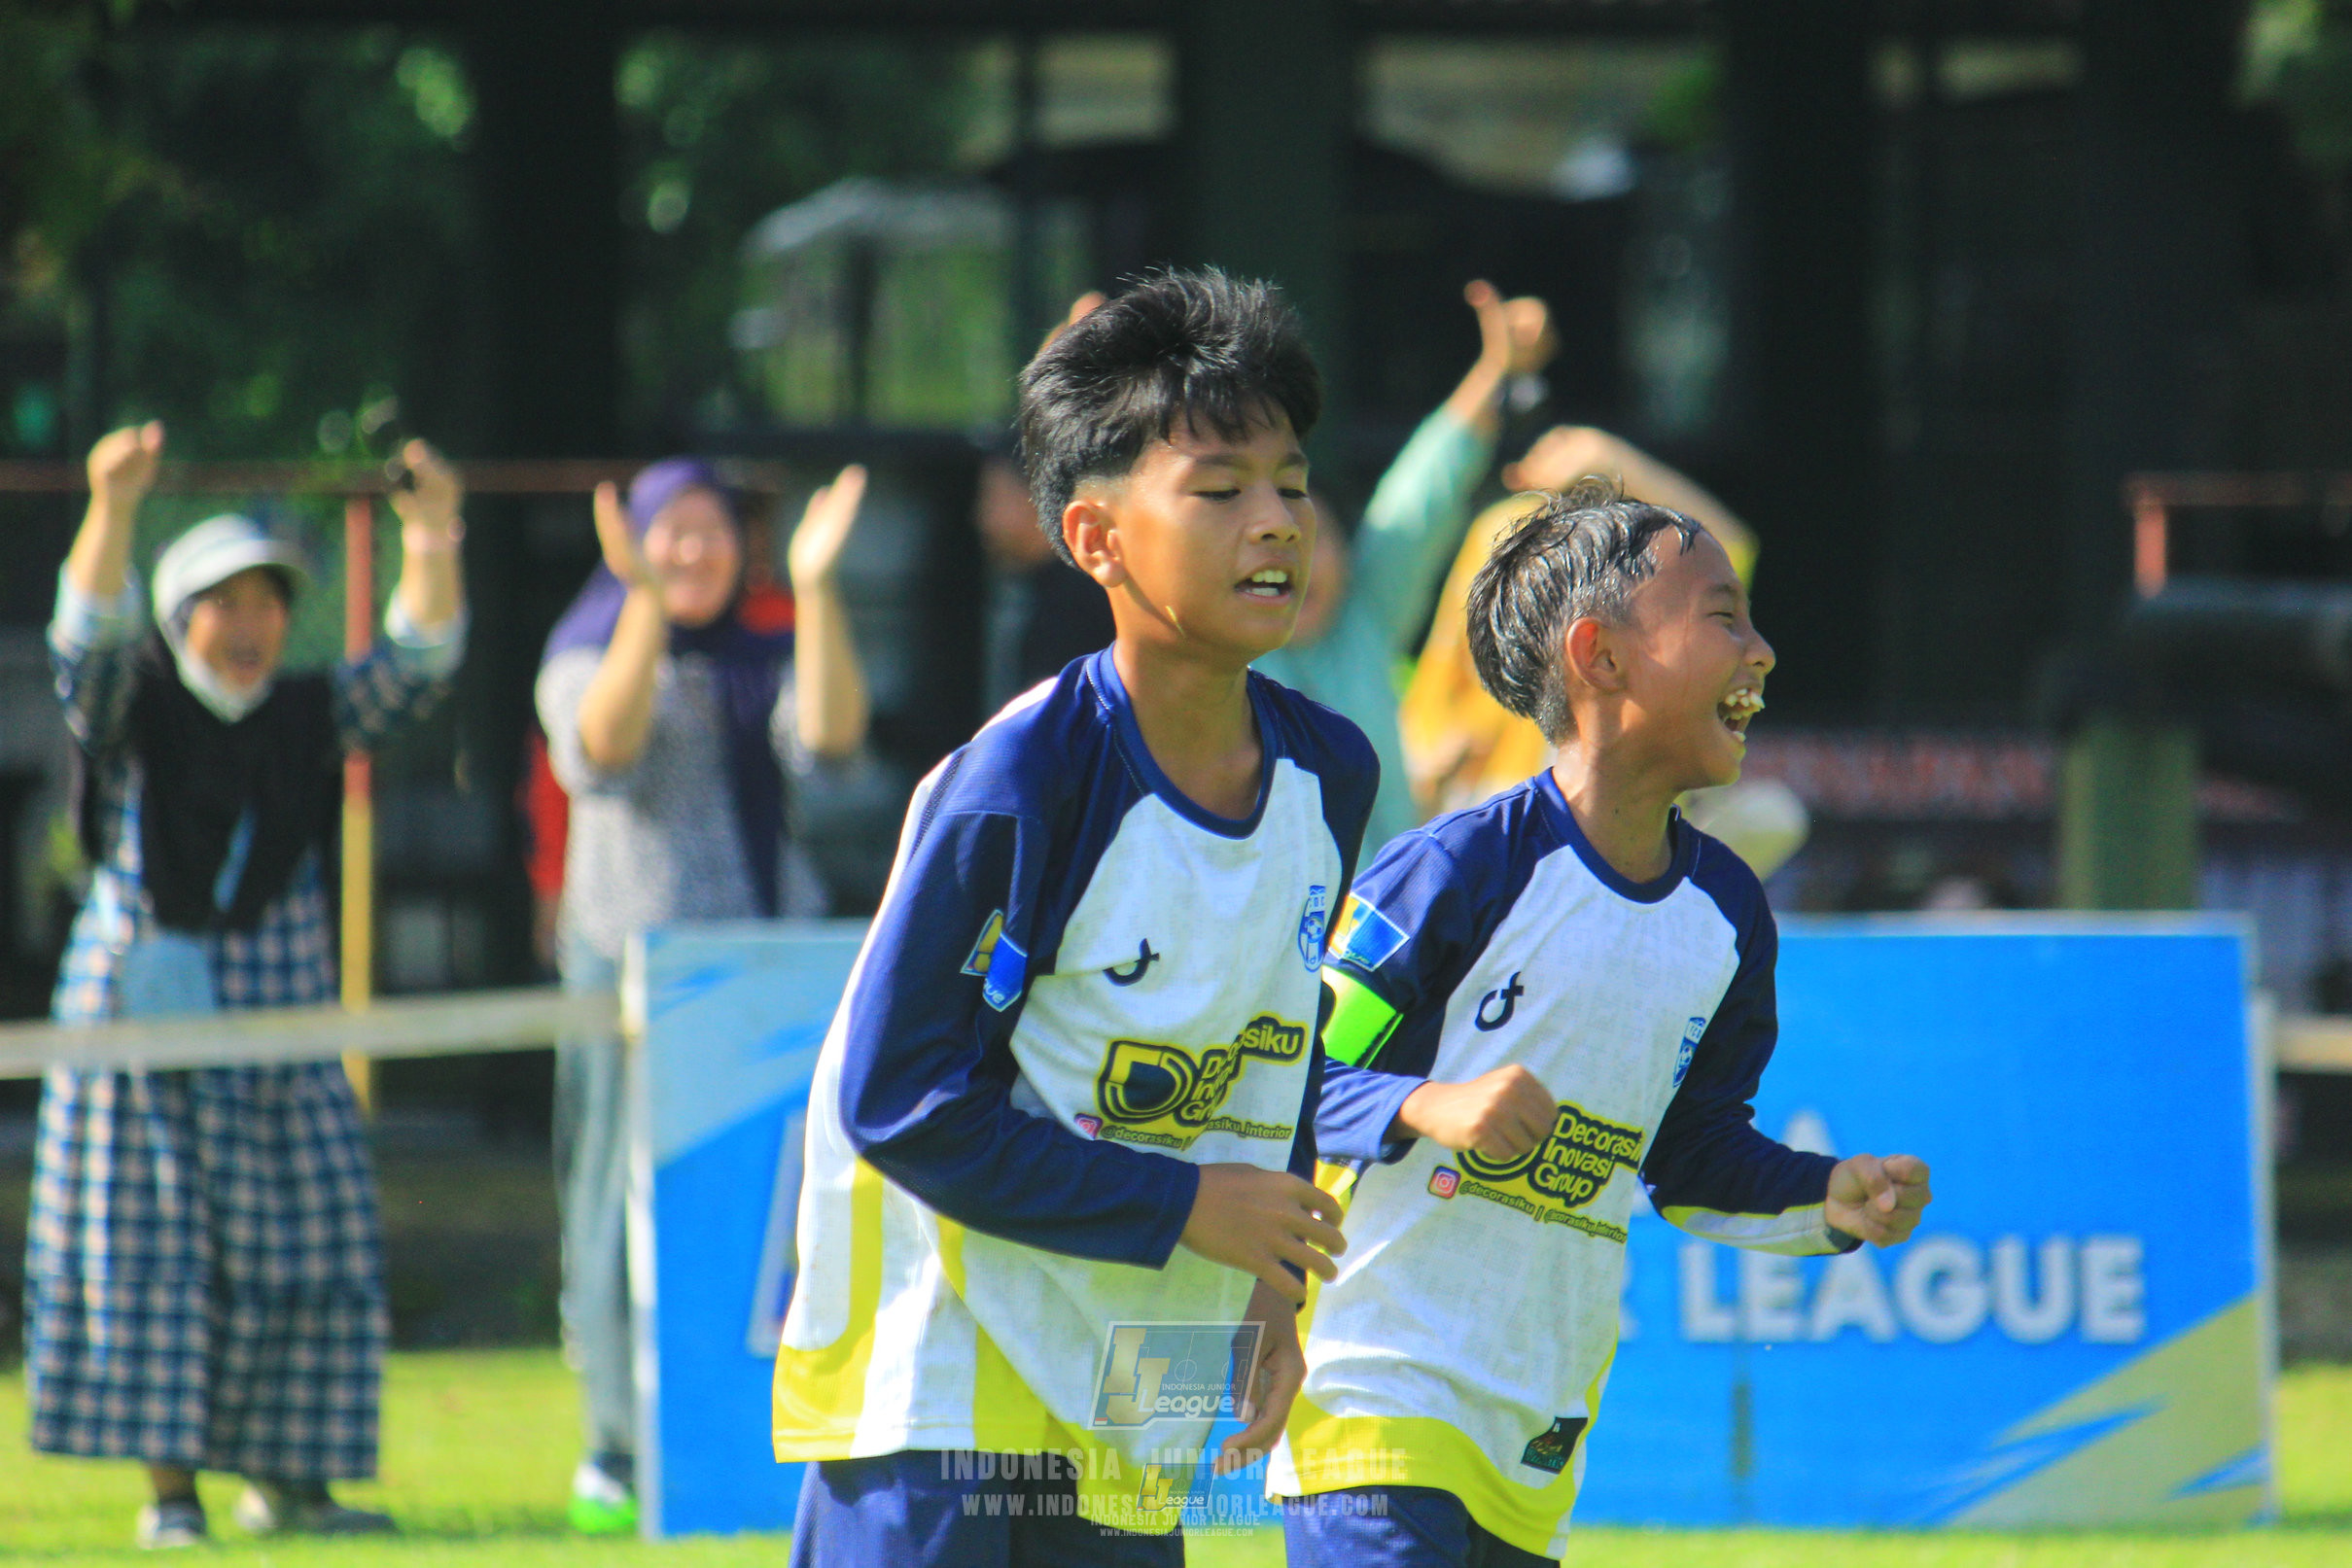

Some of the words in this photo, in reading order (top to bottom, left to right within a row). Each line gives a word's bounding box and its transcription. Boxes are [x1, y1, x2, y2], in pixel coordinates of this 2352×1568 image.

[1542, 1137, 1616, 1179] Inovasi
[1554, 1112, 1643, 1163] Decorasi
[1534, 1163, 1595, 1202] Group
[1679, 1237, 2144, 1343] LEAGUE
